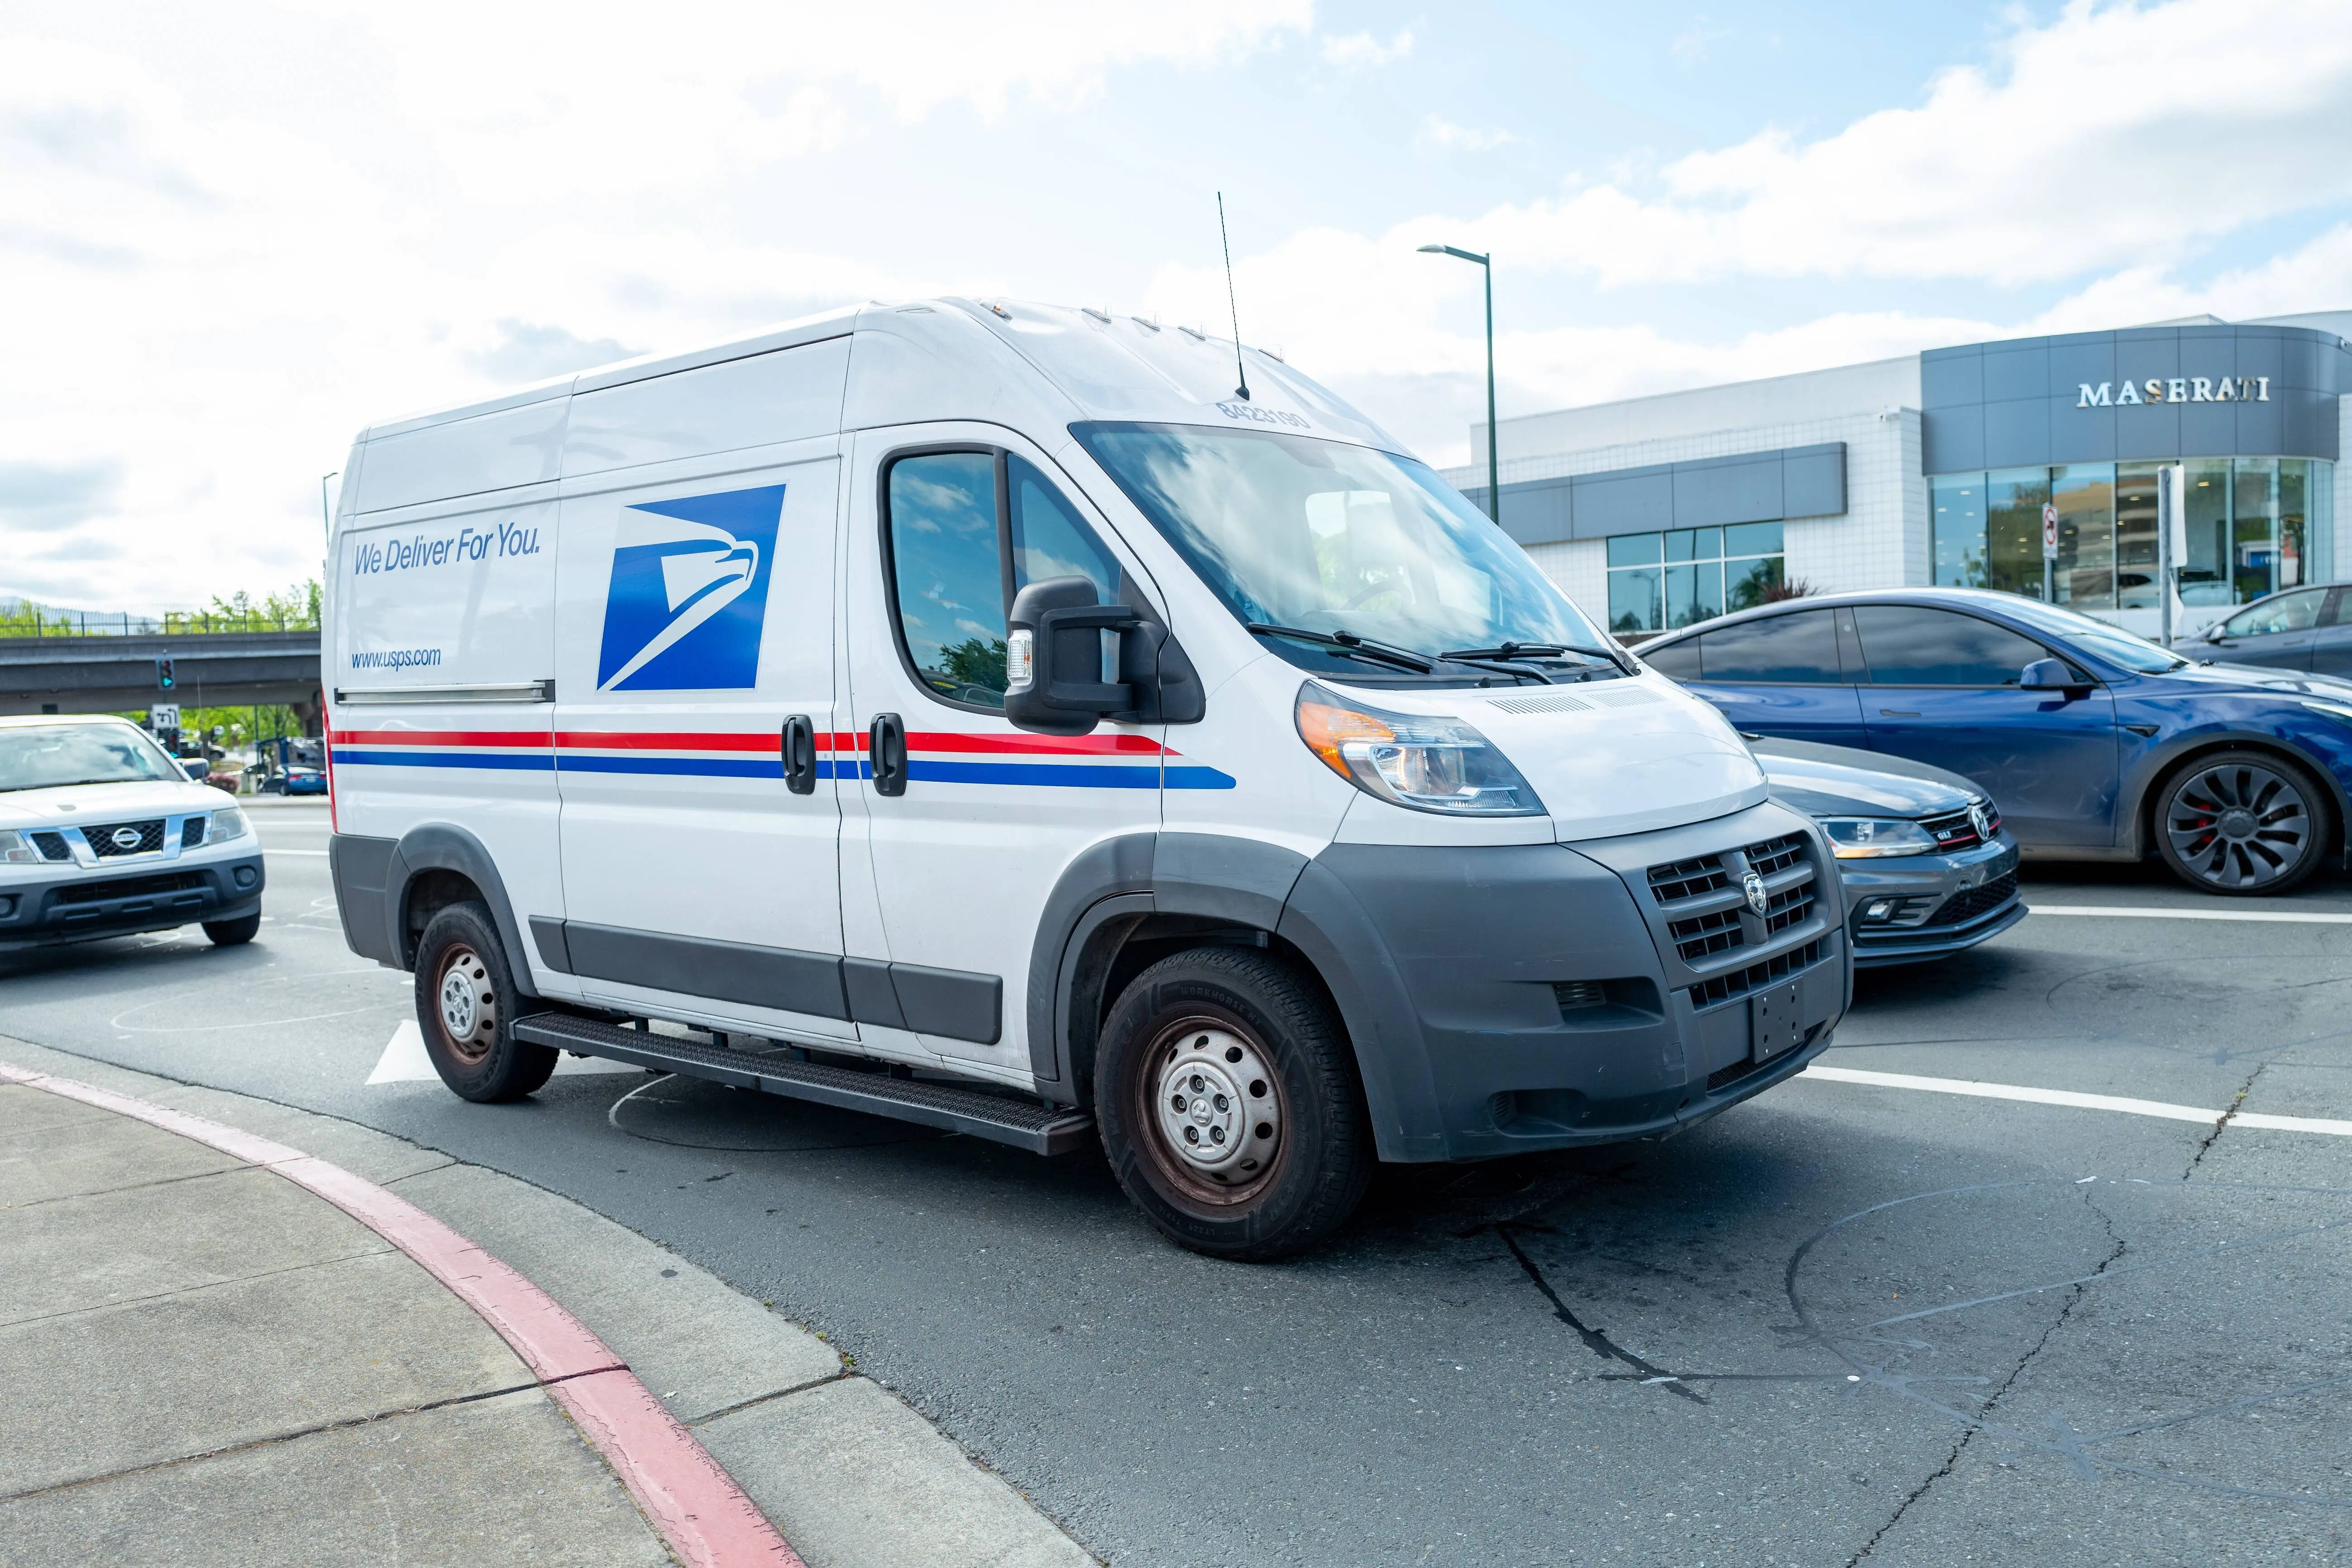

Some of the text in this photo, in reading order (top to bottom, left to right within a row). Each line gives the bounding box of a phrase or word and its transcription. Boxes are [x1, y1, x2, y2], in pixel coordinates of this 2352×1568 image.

[2076, 377, 2270, 408] MASERATI
[1215, 402, 1311, 429] 8423190
[354, 522, 540, 575] We Deliver For You.
[352, 647, 441, 672] www.usps.com
[1181, 986, 1246, 1013] WORKHORSE
[483, 977, 504, 1083] ENDURANCE
